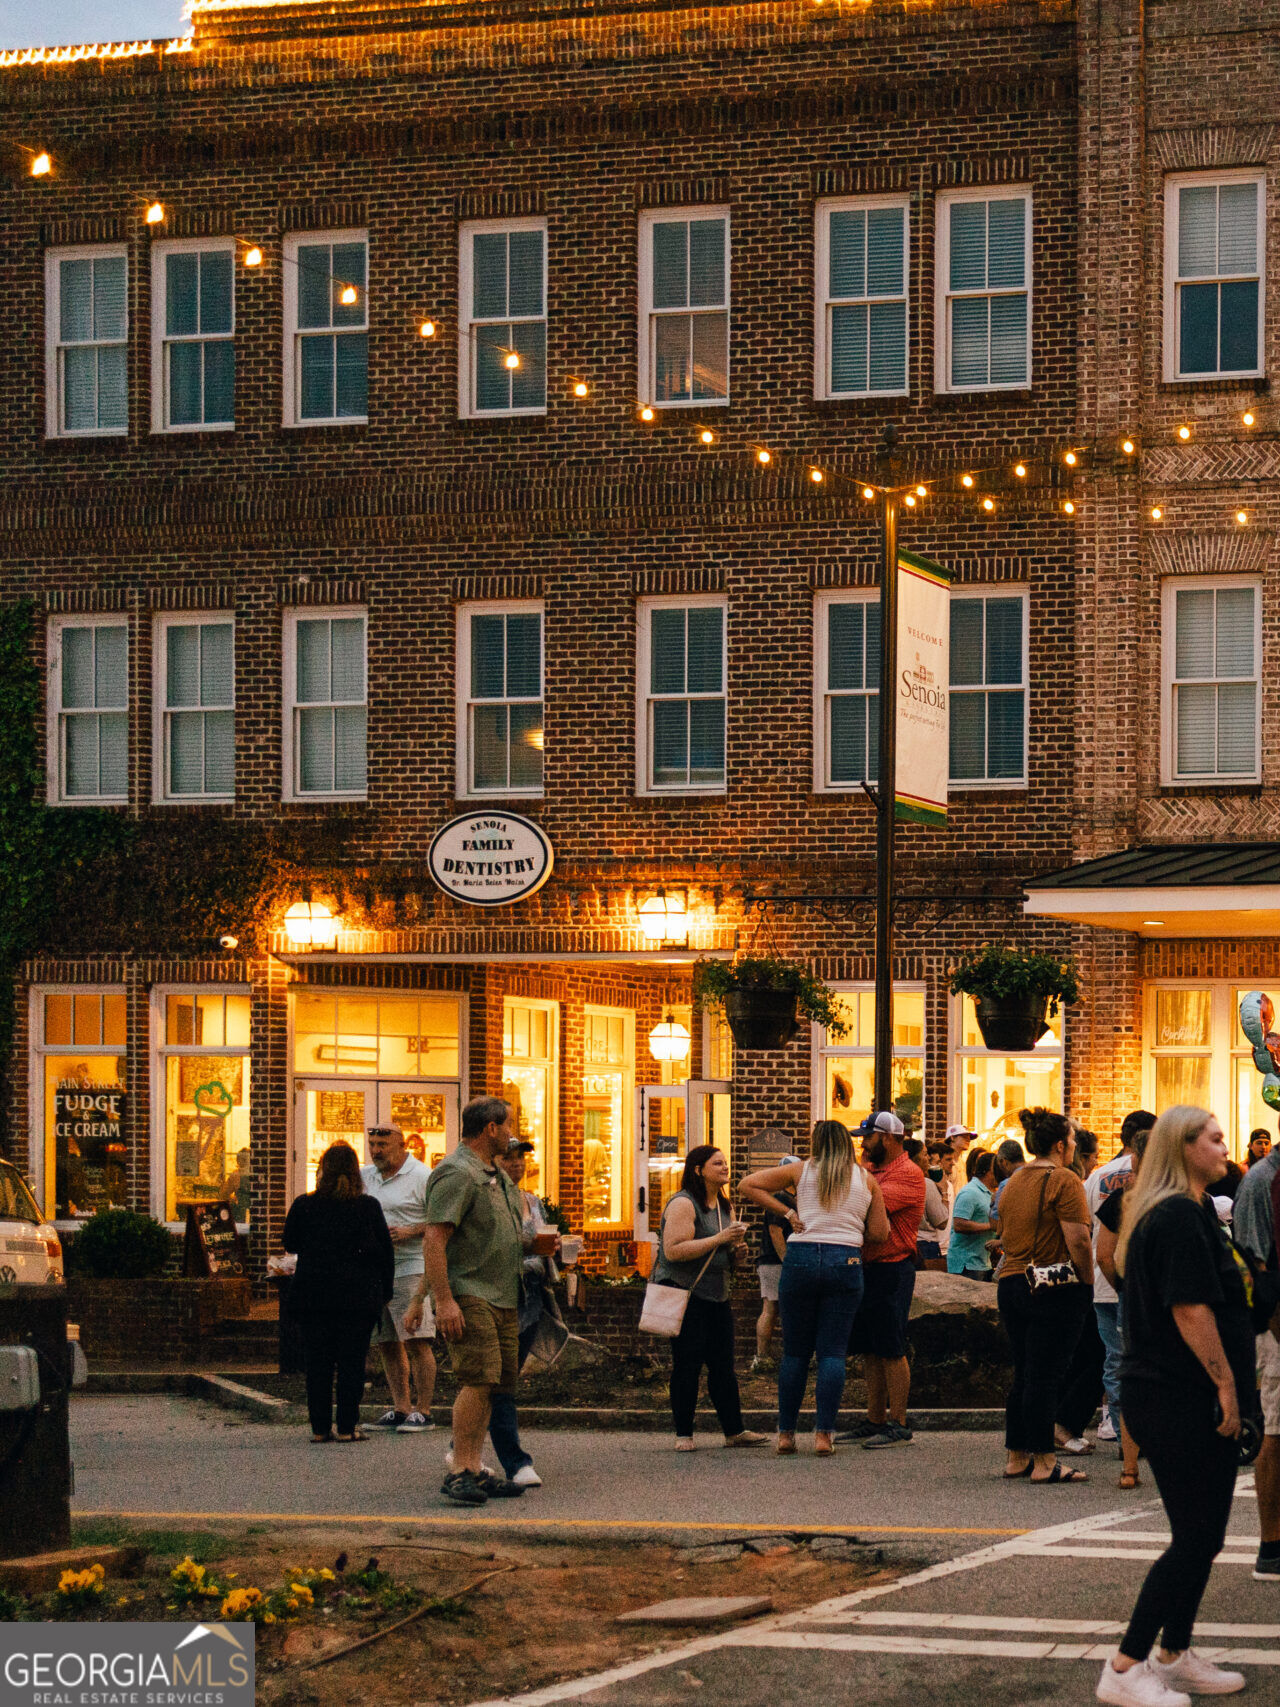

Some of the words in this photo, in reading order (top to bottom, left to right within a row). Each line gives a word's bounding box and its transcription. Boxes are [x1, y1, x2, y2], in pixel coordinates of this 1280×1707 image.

[907, 625, 943, 647] WELCOME
[900, 669, 946, 711] Senoia
[470, 820, 507, 833] SENOIA
[462, 839, 515, 851] FAMILY
[442, 857, 535, 876] DENTISTRY
[54, 1094, 122, 1115] FUDGE
[82, 1110, 90, 1120] &
[53, 1122, 72, 1137] ICE
[74, 1122, 121, 1137] CREAM
[657, 1139, 678, 1151] Open
